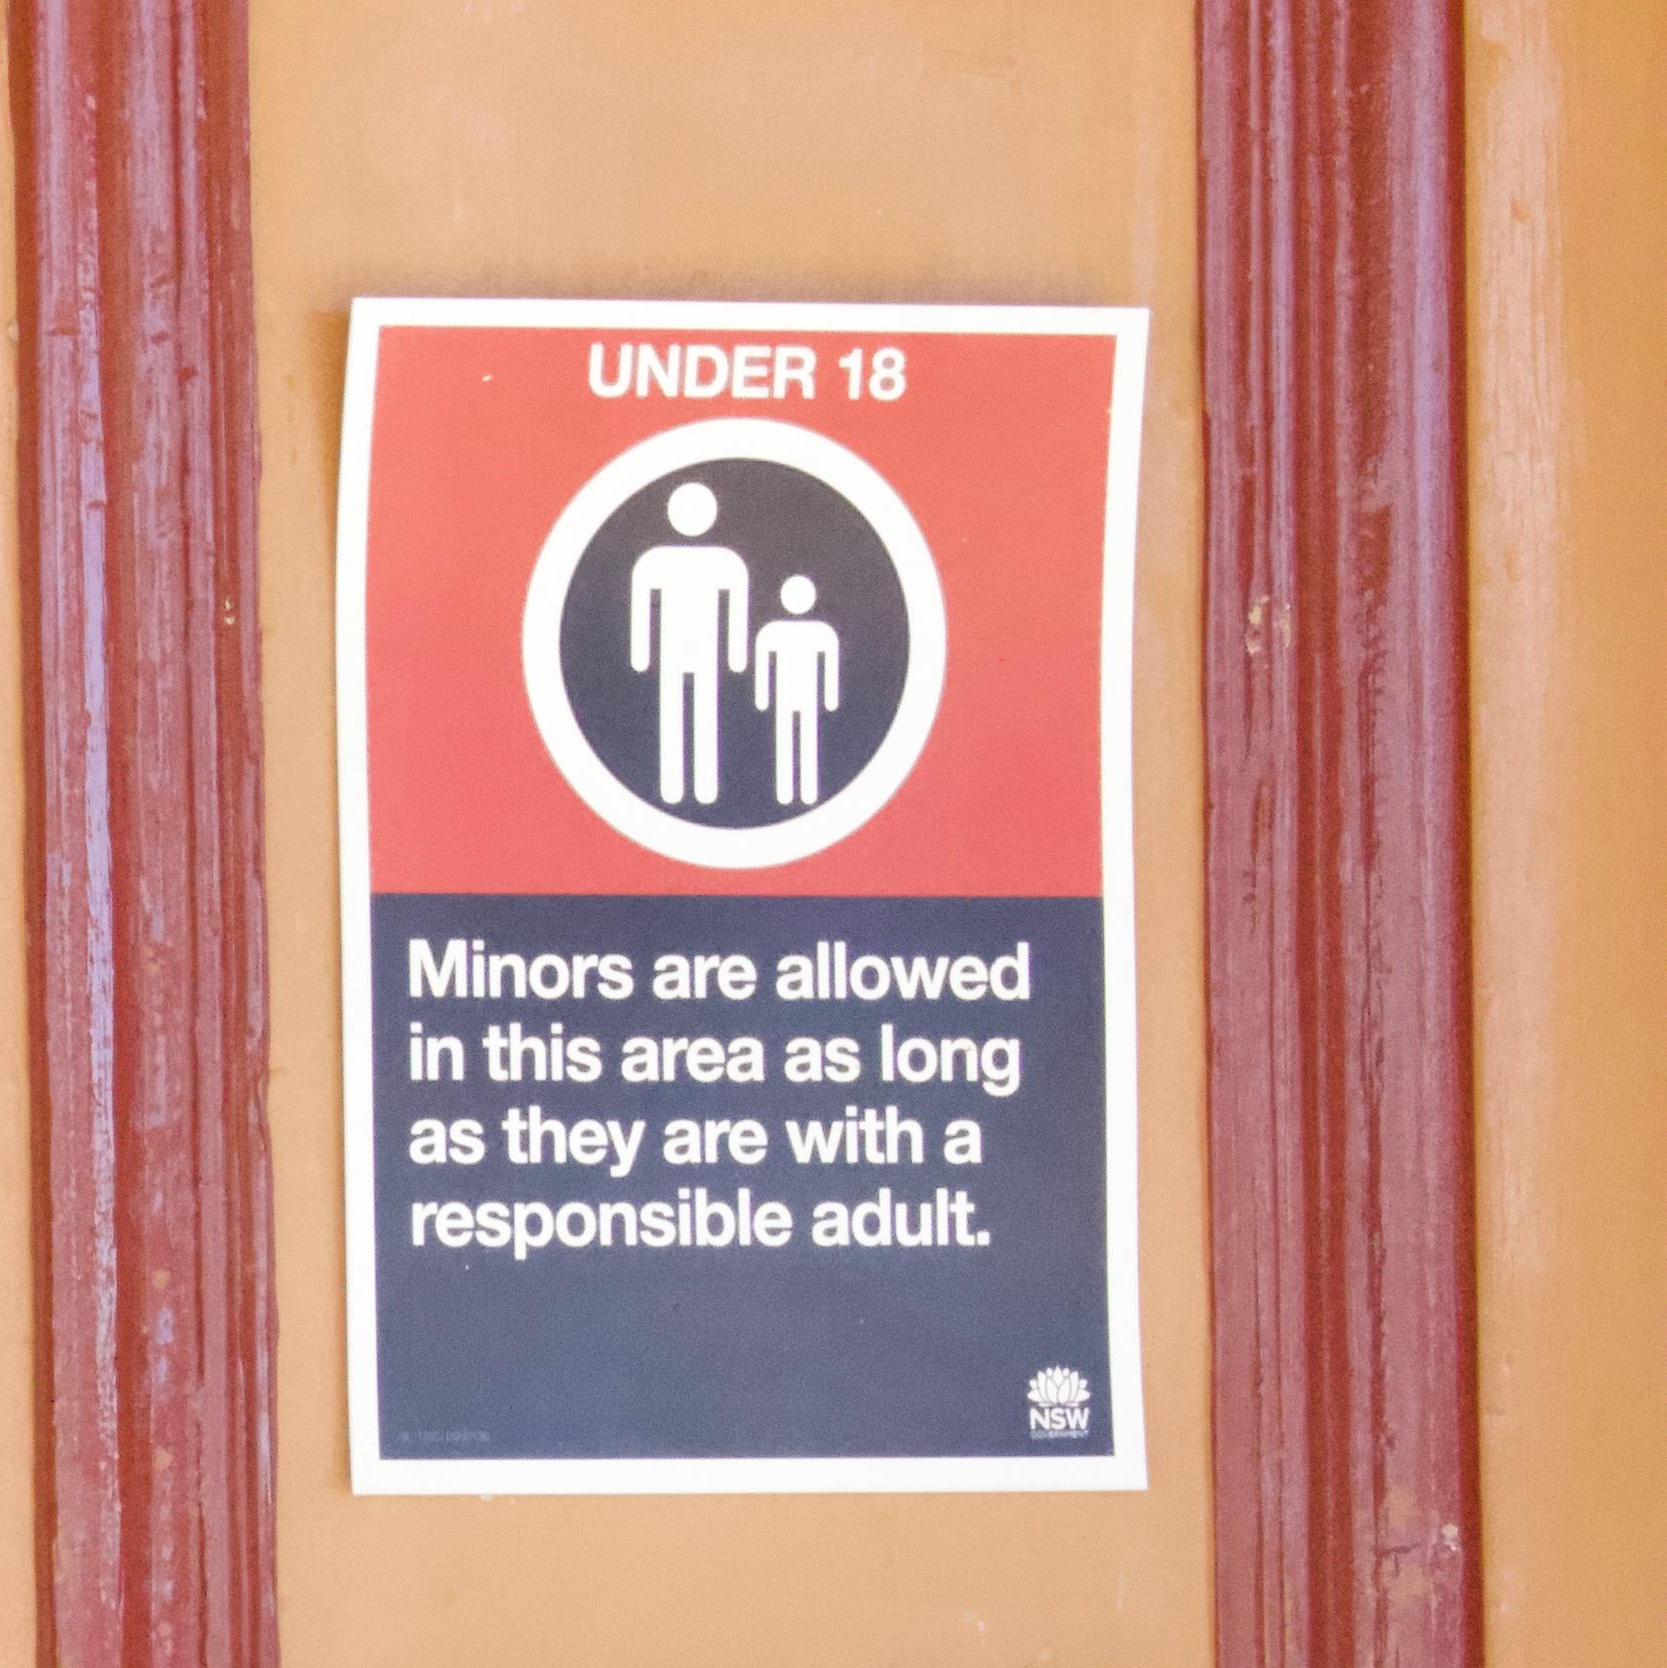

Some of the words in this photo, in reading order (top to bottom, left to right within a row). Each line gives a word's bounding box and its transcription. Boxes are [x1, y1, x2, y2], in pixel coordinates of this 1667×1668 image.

[589, 343, 816, 398] UNDER
[839, 347, 906, 400] 18
[409, 939, 634, 999] Minors
[653, 955, 757, 1000] are
[776, 941, 1030, 1000] allowed
[410, 1022, 464, 1080] in
[482, 1022, 602, 1082] this
[621, 1037, 764, 1082] area
[785, 1037, 860, 1082] as
[881, 1024, 1020, 1097] long
[409, 1119, 485, 1164] as
[502, 1105, 645, 1177] they
[663, 1119, 767, 1164] are
[785, 1105, 923, 1164] with
[944, 1120, 981, 1164] a
[412, 1188, 793, 1260] responsible
[812, 1188, 990, 1247] adult.
[1030, 1407, 1089, 1430] NSW
